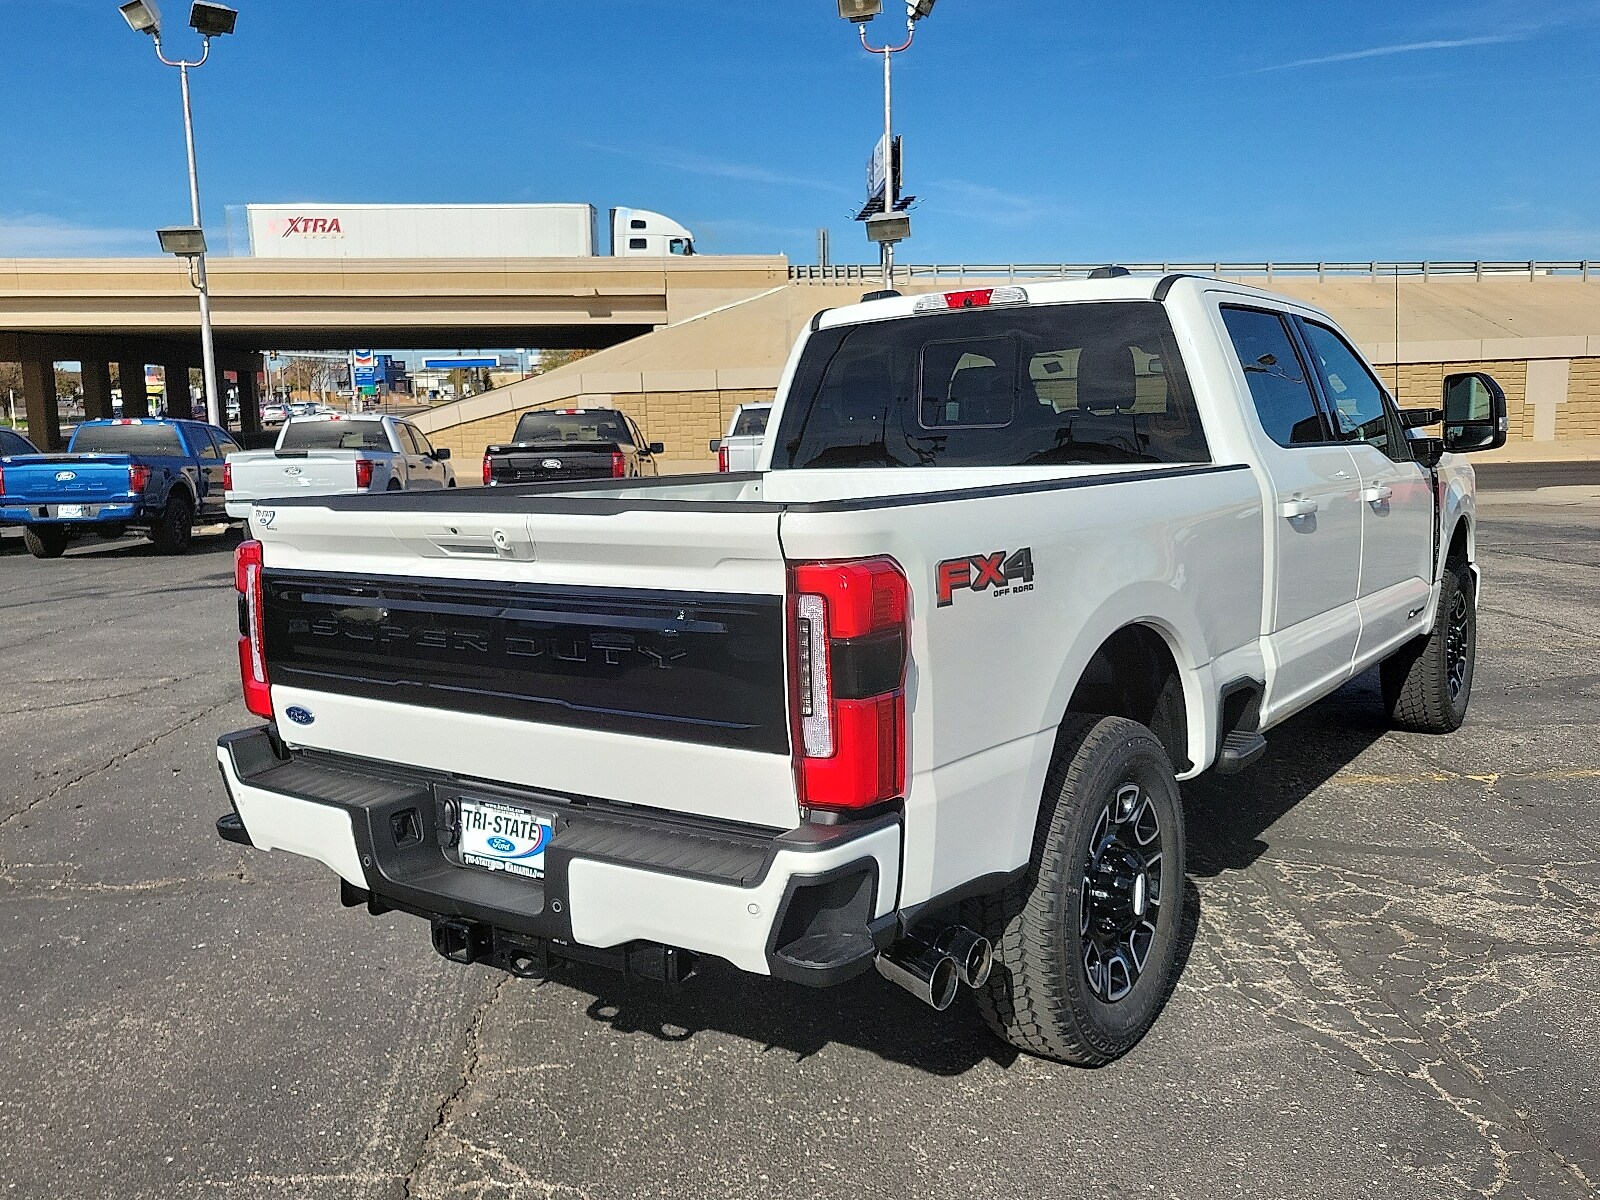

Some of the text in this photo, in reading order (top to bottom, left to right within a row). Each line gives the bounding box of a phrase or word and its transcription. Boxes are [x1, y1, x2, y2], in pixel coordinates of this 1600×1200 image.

[282, 217, 341, 237] XTRA
[934, 547, 1034, 608] FX4
[993, 584, 1034, 598] OFF ROAD
[311, 617, 688, 670] SUPER DUTY
[463, 809, 537, 841] TRI-STATE
[492, 838, 510, 851] Ford
